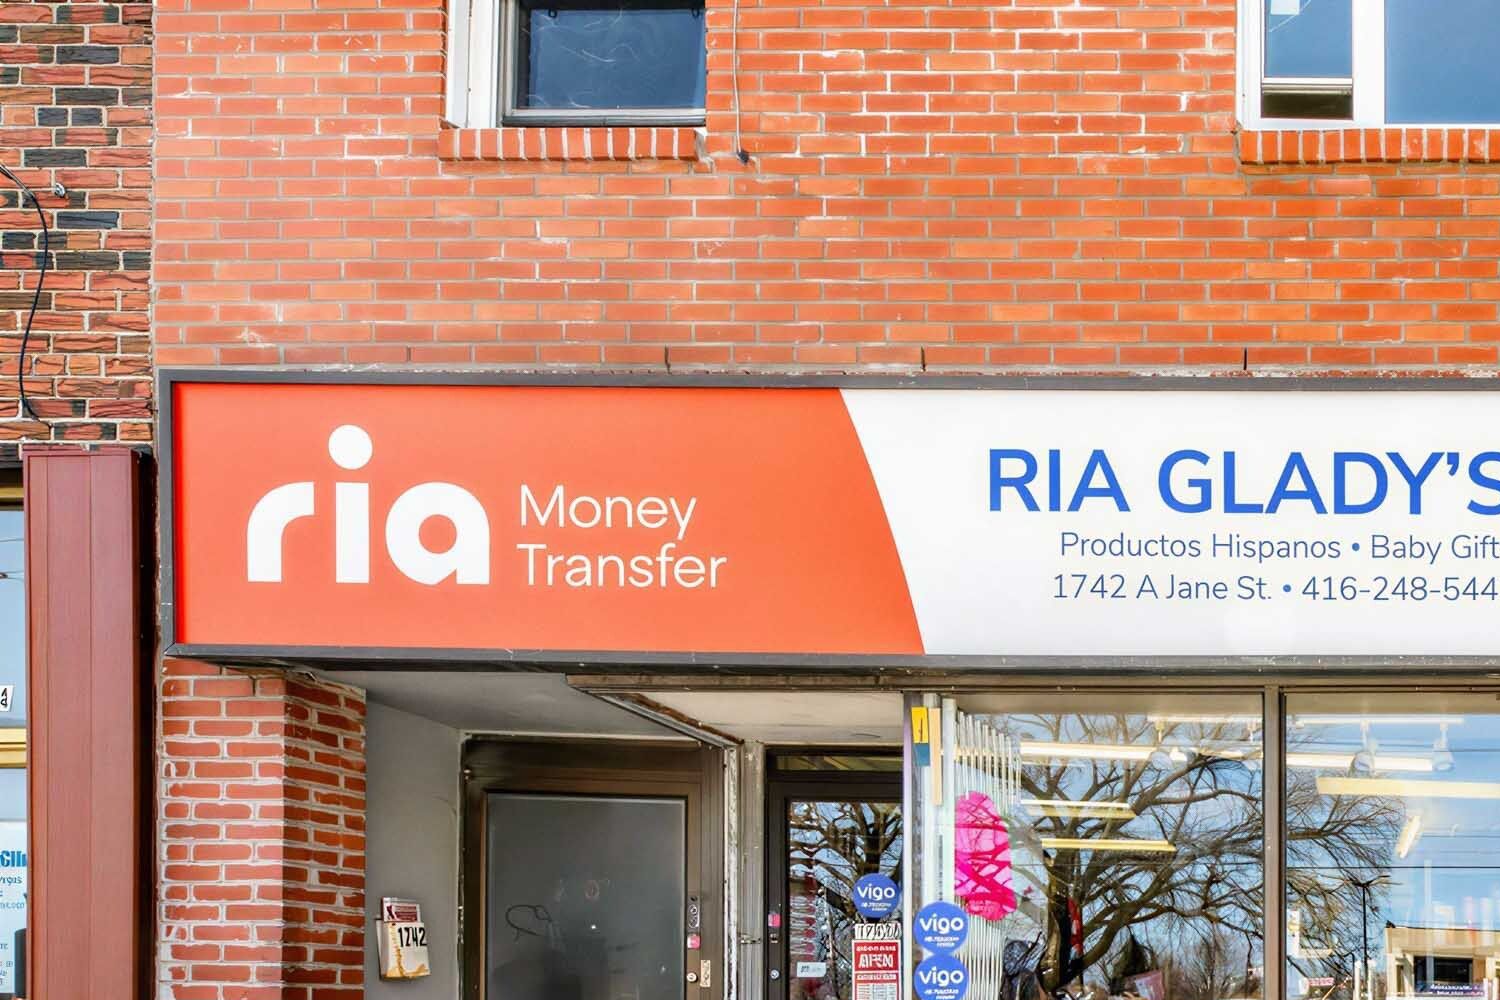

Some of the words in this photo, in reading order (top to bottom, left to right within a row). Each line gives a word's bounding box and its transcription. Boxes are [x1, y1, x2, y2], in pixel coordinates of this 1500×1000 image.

[988, 448, 1132, 513] RIA
[247, 424, 491, 586] ria
[517, 483, 697, 541] Money
[1060, 531, 1201, 558] Productos
[1211, 532, 1341, 562] Hispanos
[1370, 533, 1441, 565] Baby
[516, 542, 727, 588] Transfer
[1052, 573, 1126, 600] 1742
[1136, 574, 1158, 599] A
[1166, 574, 1228, 601] Jane
[1238, 574, 1272, 601] St.
[857, 883, 896, 902] vigo
[398, 927, 428, 947] 1742
[919, 913, 965, 935] vigo
[919, 965, 965, 987] vigo
